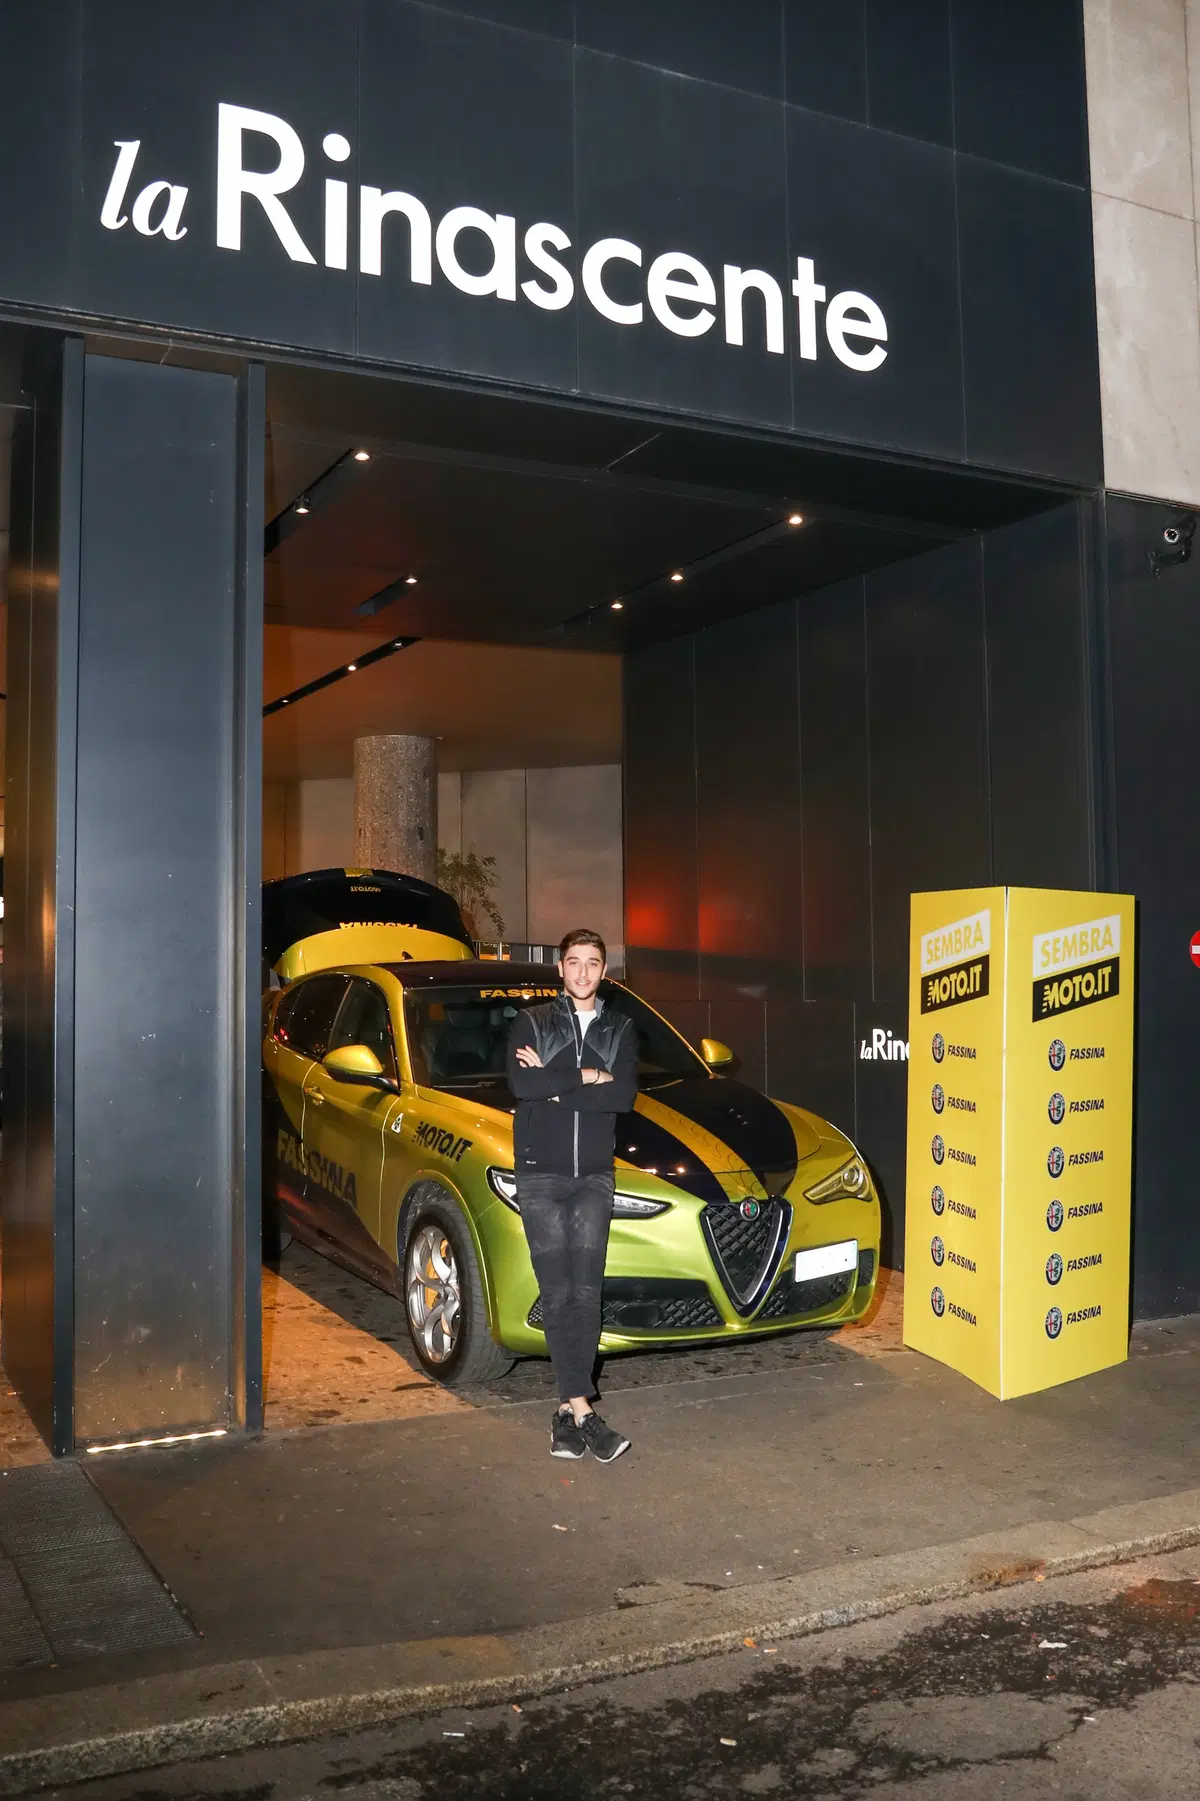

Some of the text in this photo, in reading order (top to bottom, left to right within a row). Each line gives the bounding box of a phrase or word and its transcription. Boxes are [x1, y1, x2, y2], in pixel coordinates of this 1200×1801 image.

[101, 102, 889, 373] la Rinascente
[926, 919, 984, 965] SEMBRA
[1040, 923, 1114, 968] SEMBRA
[480, 988, 558, 999] FASSIN
[927, 964, 983, 1007] MOTO.IT
[1041, 966, 1112, 1013] MOTO.IT
[948, 1045, 976, 1059] FASSINA
[1070, 1047, 1104, 1059] FASSINA
[948, 1097, 976, 1112] FASSINA
[1070, 1099, 1104, 1112] FASSINA
[412, 1121, 474, 1162] MOTO.IT
[948, 1149, 976, 1166] FASSINA
[1069, 1151, 1103, 1166] FASSINA
[277, 1129, 358, 1212] FASSINA
[948, 1200, 976, 1219] FASSINA
[1068, 1202, 1102, 1218] FASSINA
[948, 1252, 976, 1272] FASSINA
[1067, 1254, 1101, 1271] FASSINA
[949, 1303, 976, 1326] FASSINA
[1067, 1305, 1101, 1324] FASSINA
